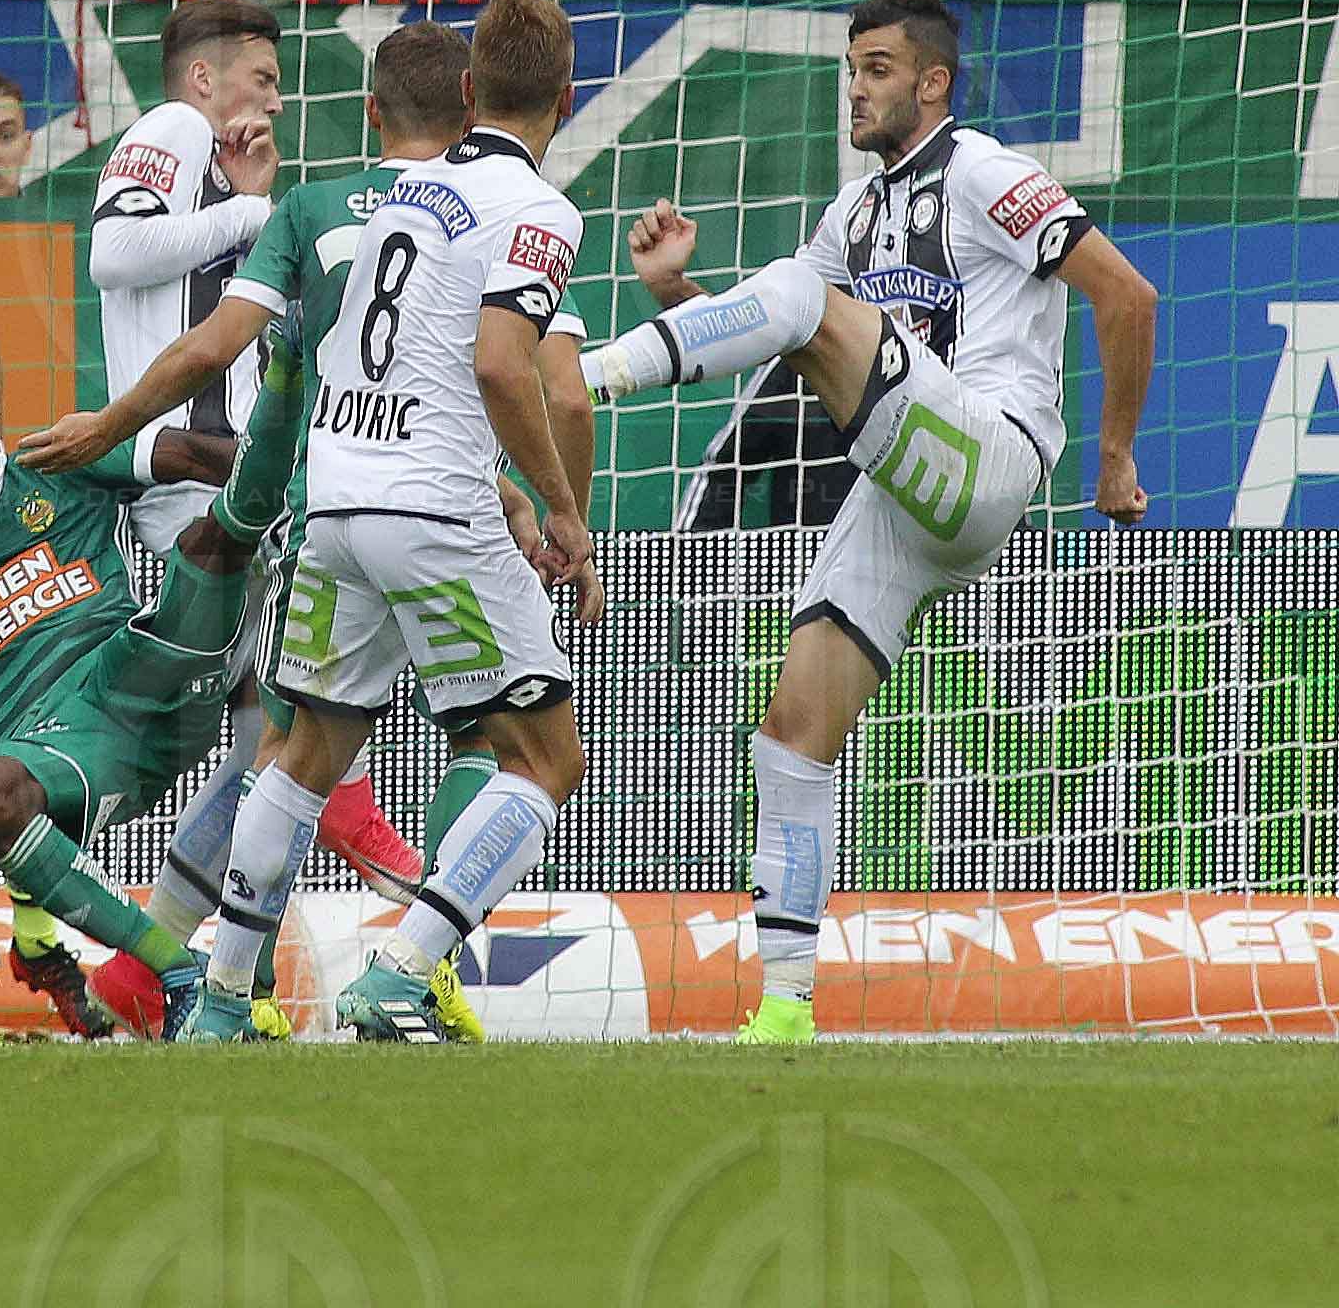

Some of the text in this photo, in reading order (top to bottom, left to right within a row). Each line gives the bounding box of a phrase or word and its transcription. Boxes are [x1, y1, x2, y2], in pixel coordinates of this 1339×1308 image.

[512, 243, 569, 290] ZEITUN
[518, 228, 573, 267] KLEIN
[360, 231, 419, 382] 8
[679, 298, 764, 345] PUNTIGAMER
[313, 384, 420, 441] LOVRIC
[453, 799, 531, 895] PUNTIGAMER
